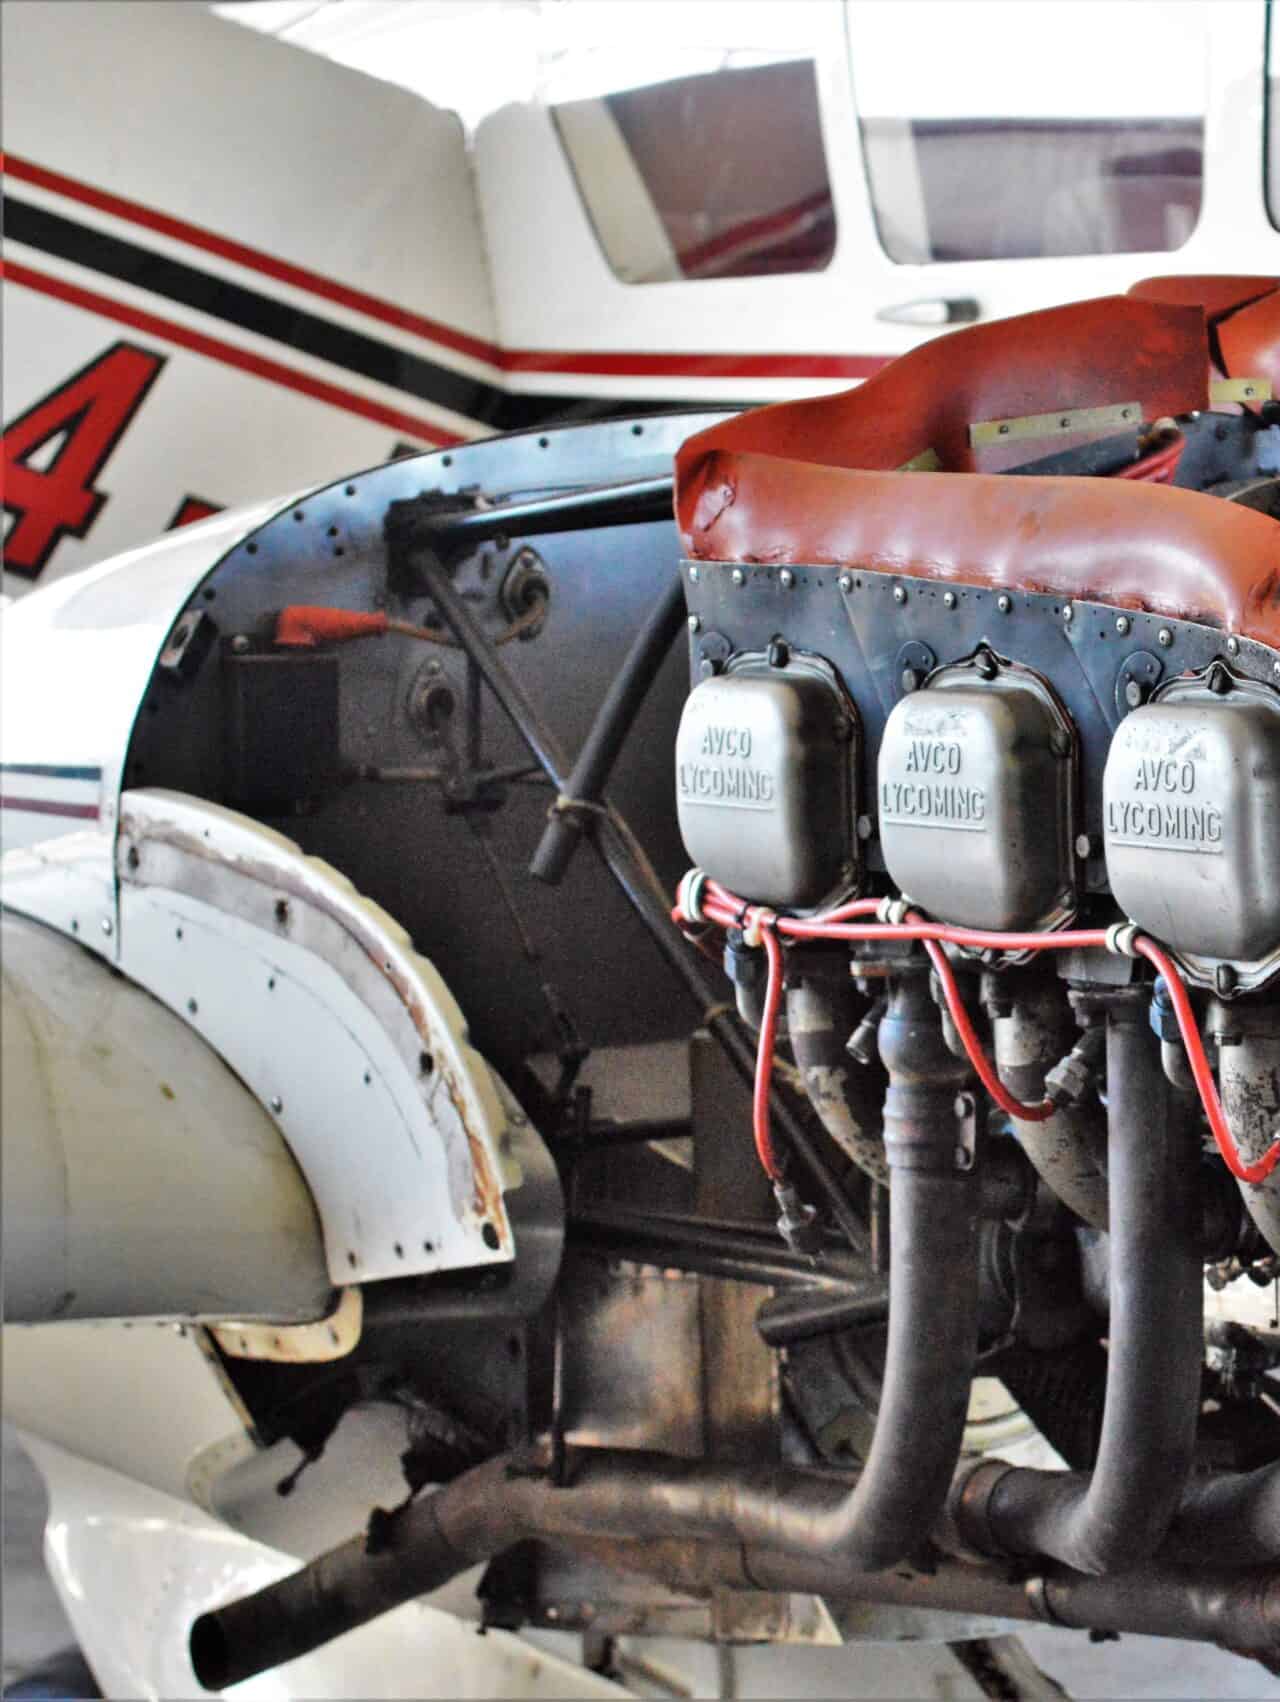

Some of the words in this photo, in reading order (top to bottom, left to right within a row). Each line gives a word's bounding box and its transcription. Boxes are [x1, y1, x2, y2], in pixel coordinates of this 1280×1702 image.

[701, 725, 752, 760] AVCO
[905, 741, 961, 776] AVCO
[680, 762, 775, 801] LYCOMING
[1134, 759, 1195, 794] AVCO
[881, 783, 985, 821] LYCOMING
[1108, 801, 1223, 842] LYCOMING
